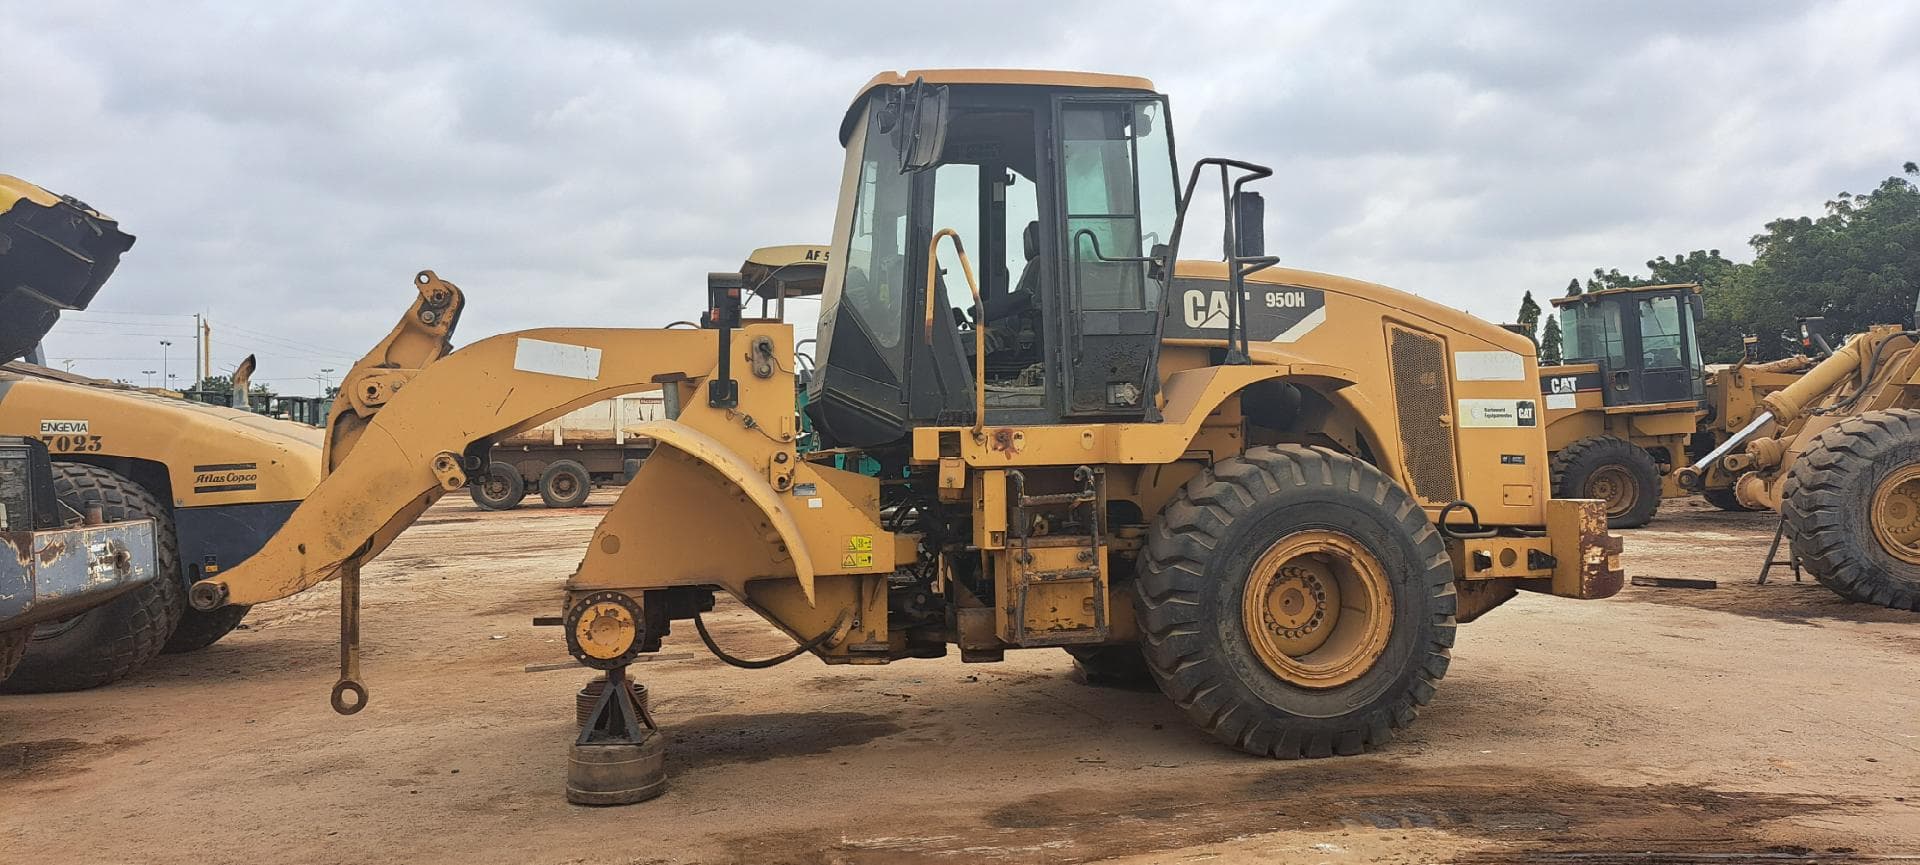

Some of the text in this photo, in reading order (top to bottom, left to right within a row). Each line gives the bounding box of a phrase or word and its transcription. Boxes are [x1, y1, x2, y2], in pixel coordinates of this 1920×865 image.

[805, 250, 821, 260] AF
[1265, 292, 1306, 308] 950H
[1551, 377, 1577, 393] CAT
[1518, 408, 1533, 419] CAT
[41, 422, 88, 432] ENGEVIA
[42, 435, 104, 452] 7023
[195, 472, 258, 484] Atlas Copco
